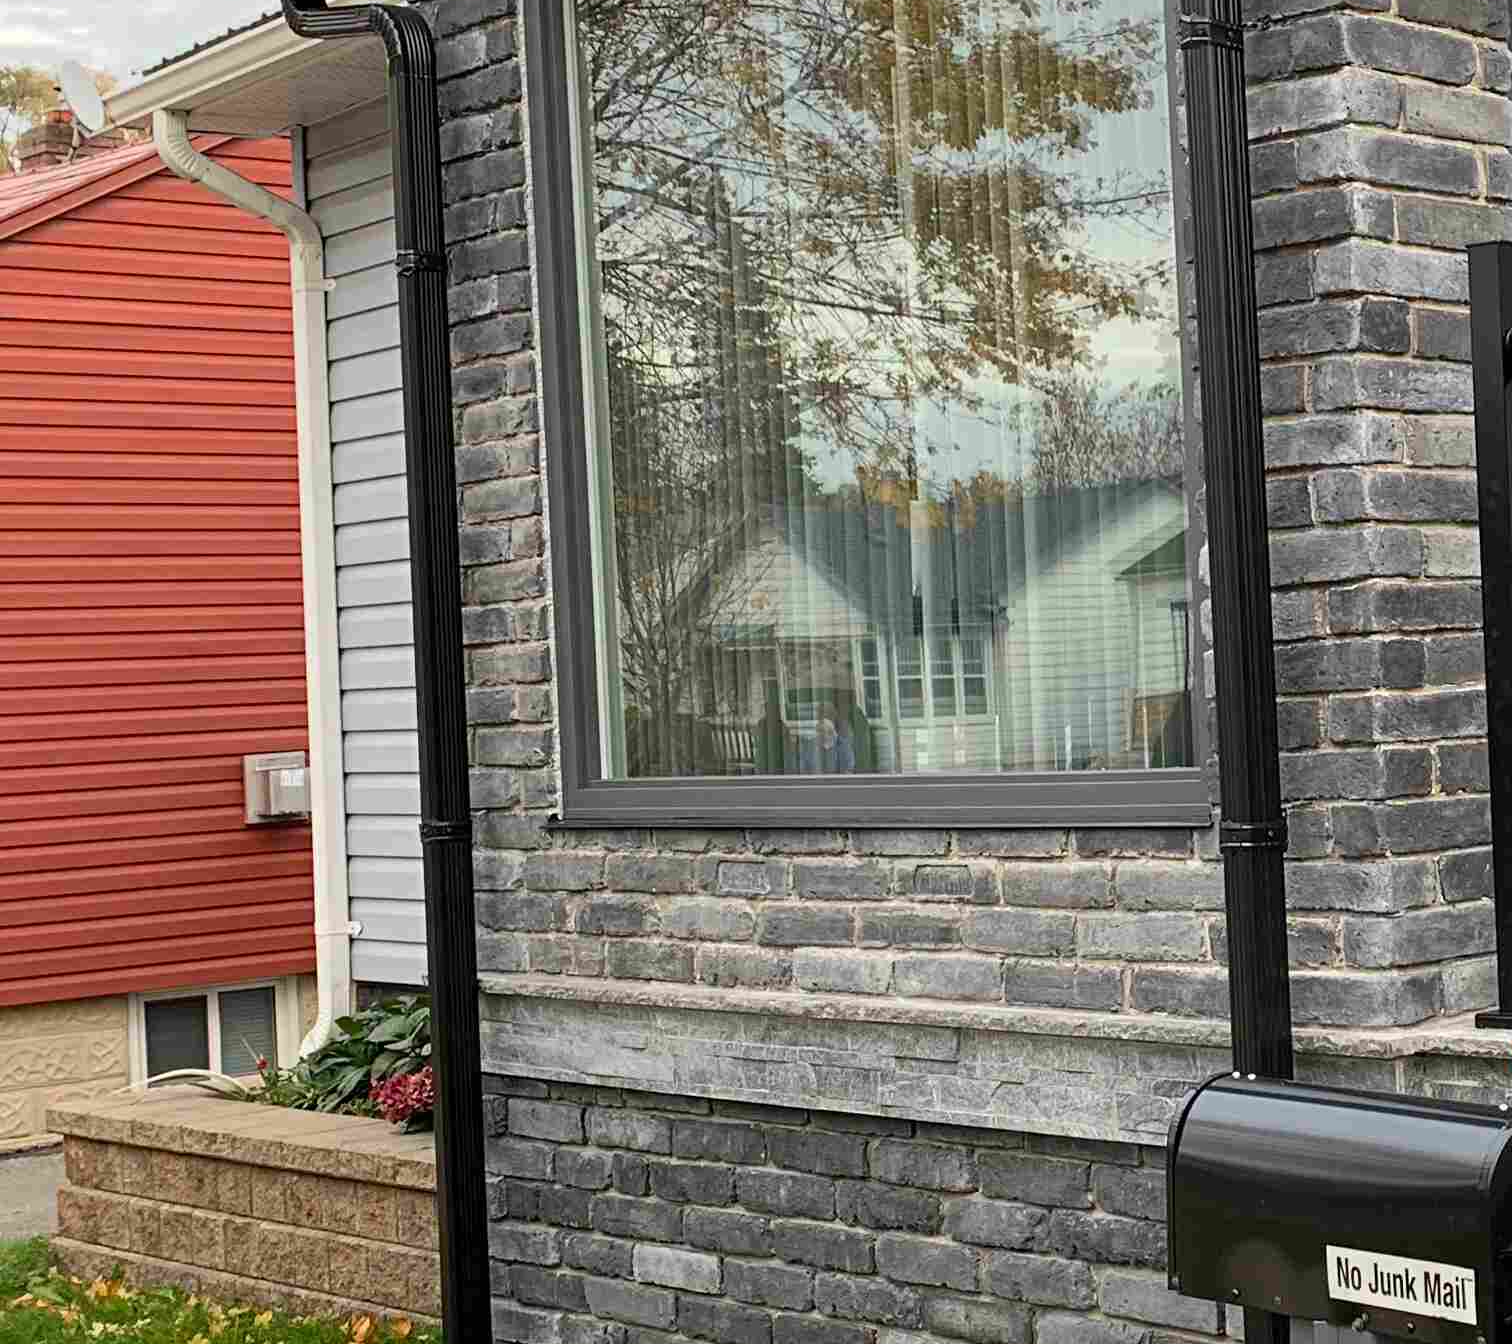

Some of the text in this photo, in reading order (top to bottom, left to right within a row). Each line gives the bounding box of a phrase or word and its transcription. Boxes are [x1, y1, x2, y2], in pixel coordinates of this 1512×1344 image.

[1336, 1255, 1467, 1311] No Junk Mail
